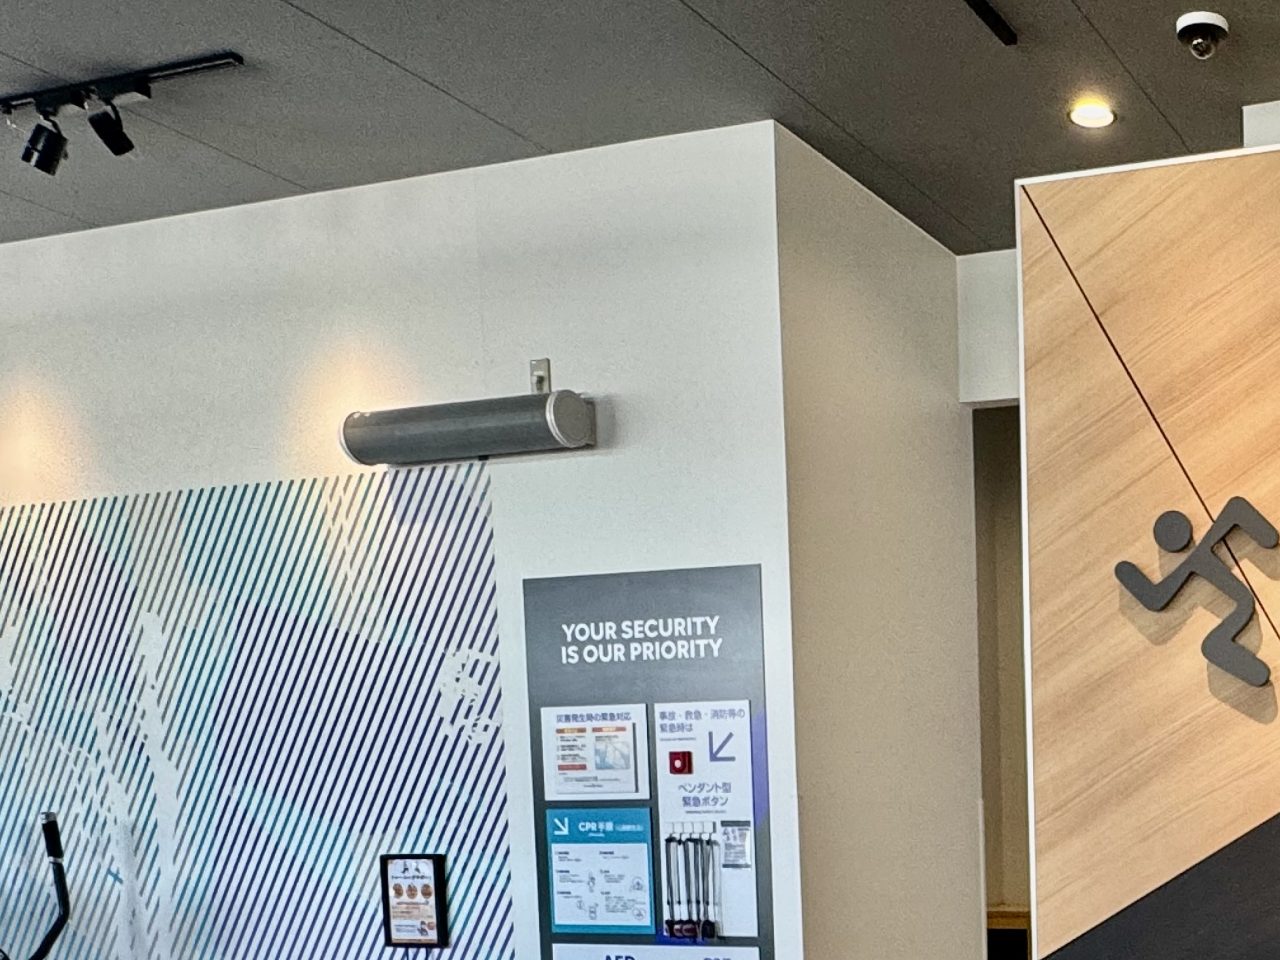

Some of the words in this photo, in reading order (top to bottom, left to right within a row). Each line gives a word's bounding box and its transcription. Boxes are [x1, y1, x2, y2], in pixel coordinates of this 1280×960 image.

[561, 621, 617, 642] YOUR
[621, 616, 720, 639] SECURITY
[561, 646, 579, 664] IS
[583, 643, 625, 663] OUR
[630, 638, 723, 661] PRIORITY
[682, 796, 729, 807] 緊急ボタン
